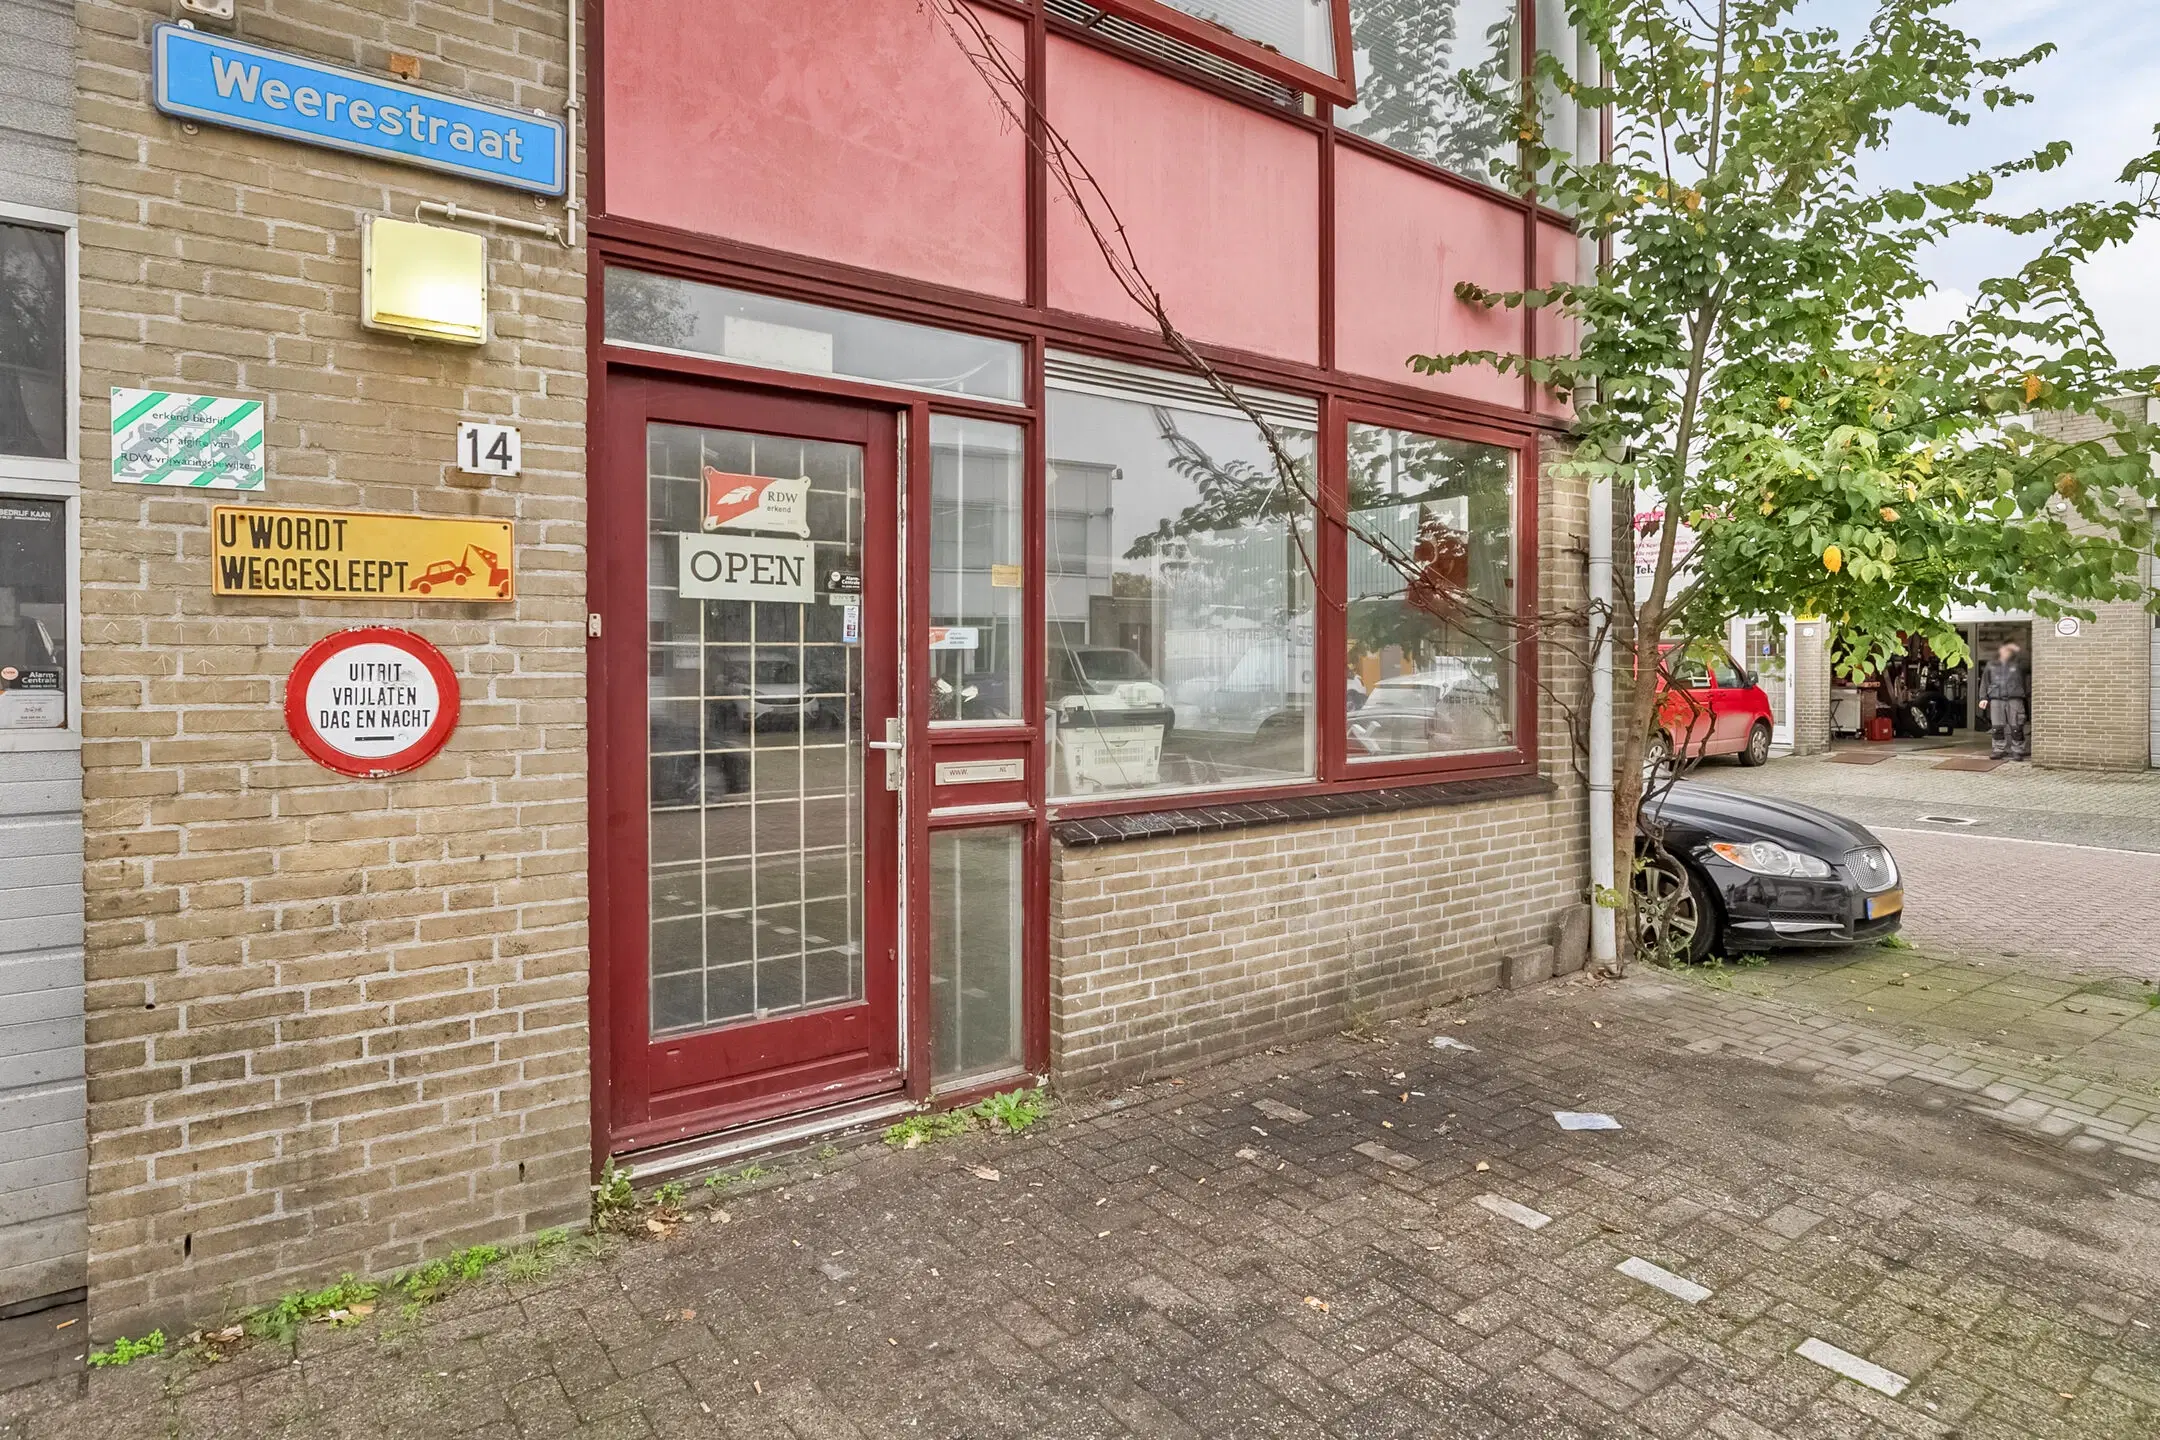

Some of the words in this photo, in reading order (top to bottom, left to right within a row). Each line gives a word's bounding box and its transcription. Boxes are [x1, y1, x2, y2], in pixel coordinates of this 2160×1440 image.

[211, 55, 524, 164] Weerestraat
[152, 412, 189, 423] erkend
[193, 414, 228, 426] bedrijf
[148, 436, 174, 445] voor
[178, 437, 210, 449] afgifte
[213, 440, 230, 449] van
[466, 428, 513, 470] 14
[120, 452, 257, 471] RDW-vrijwaringsbewijzen
[767, 491, 798, 503] RDW
[766, 505, 791, 513] erkend
[219, 513, 237, 548] U
[248, 515, 348, 551] WORDT
[219, 555, 408, 593] WEGGESLEEPT
[690, 550, 805, 587] OPEN
[349, 663, 402, 682] UITRIT
[333, 687, 416, 706] VRIJLATEN
[320, 710, 350, 729] DAG
[356, 710, 376, 728] EN
[381, 709, 430, 728] NACHT
